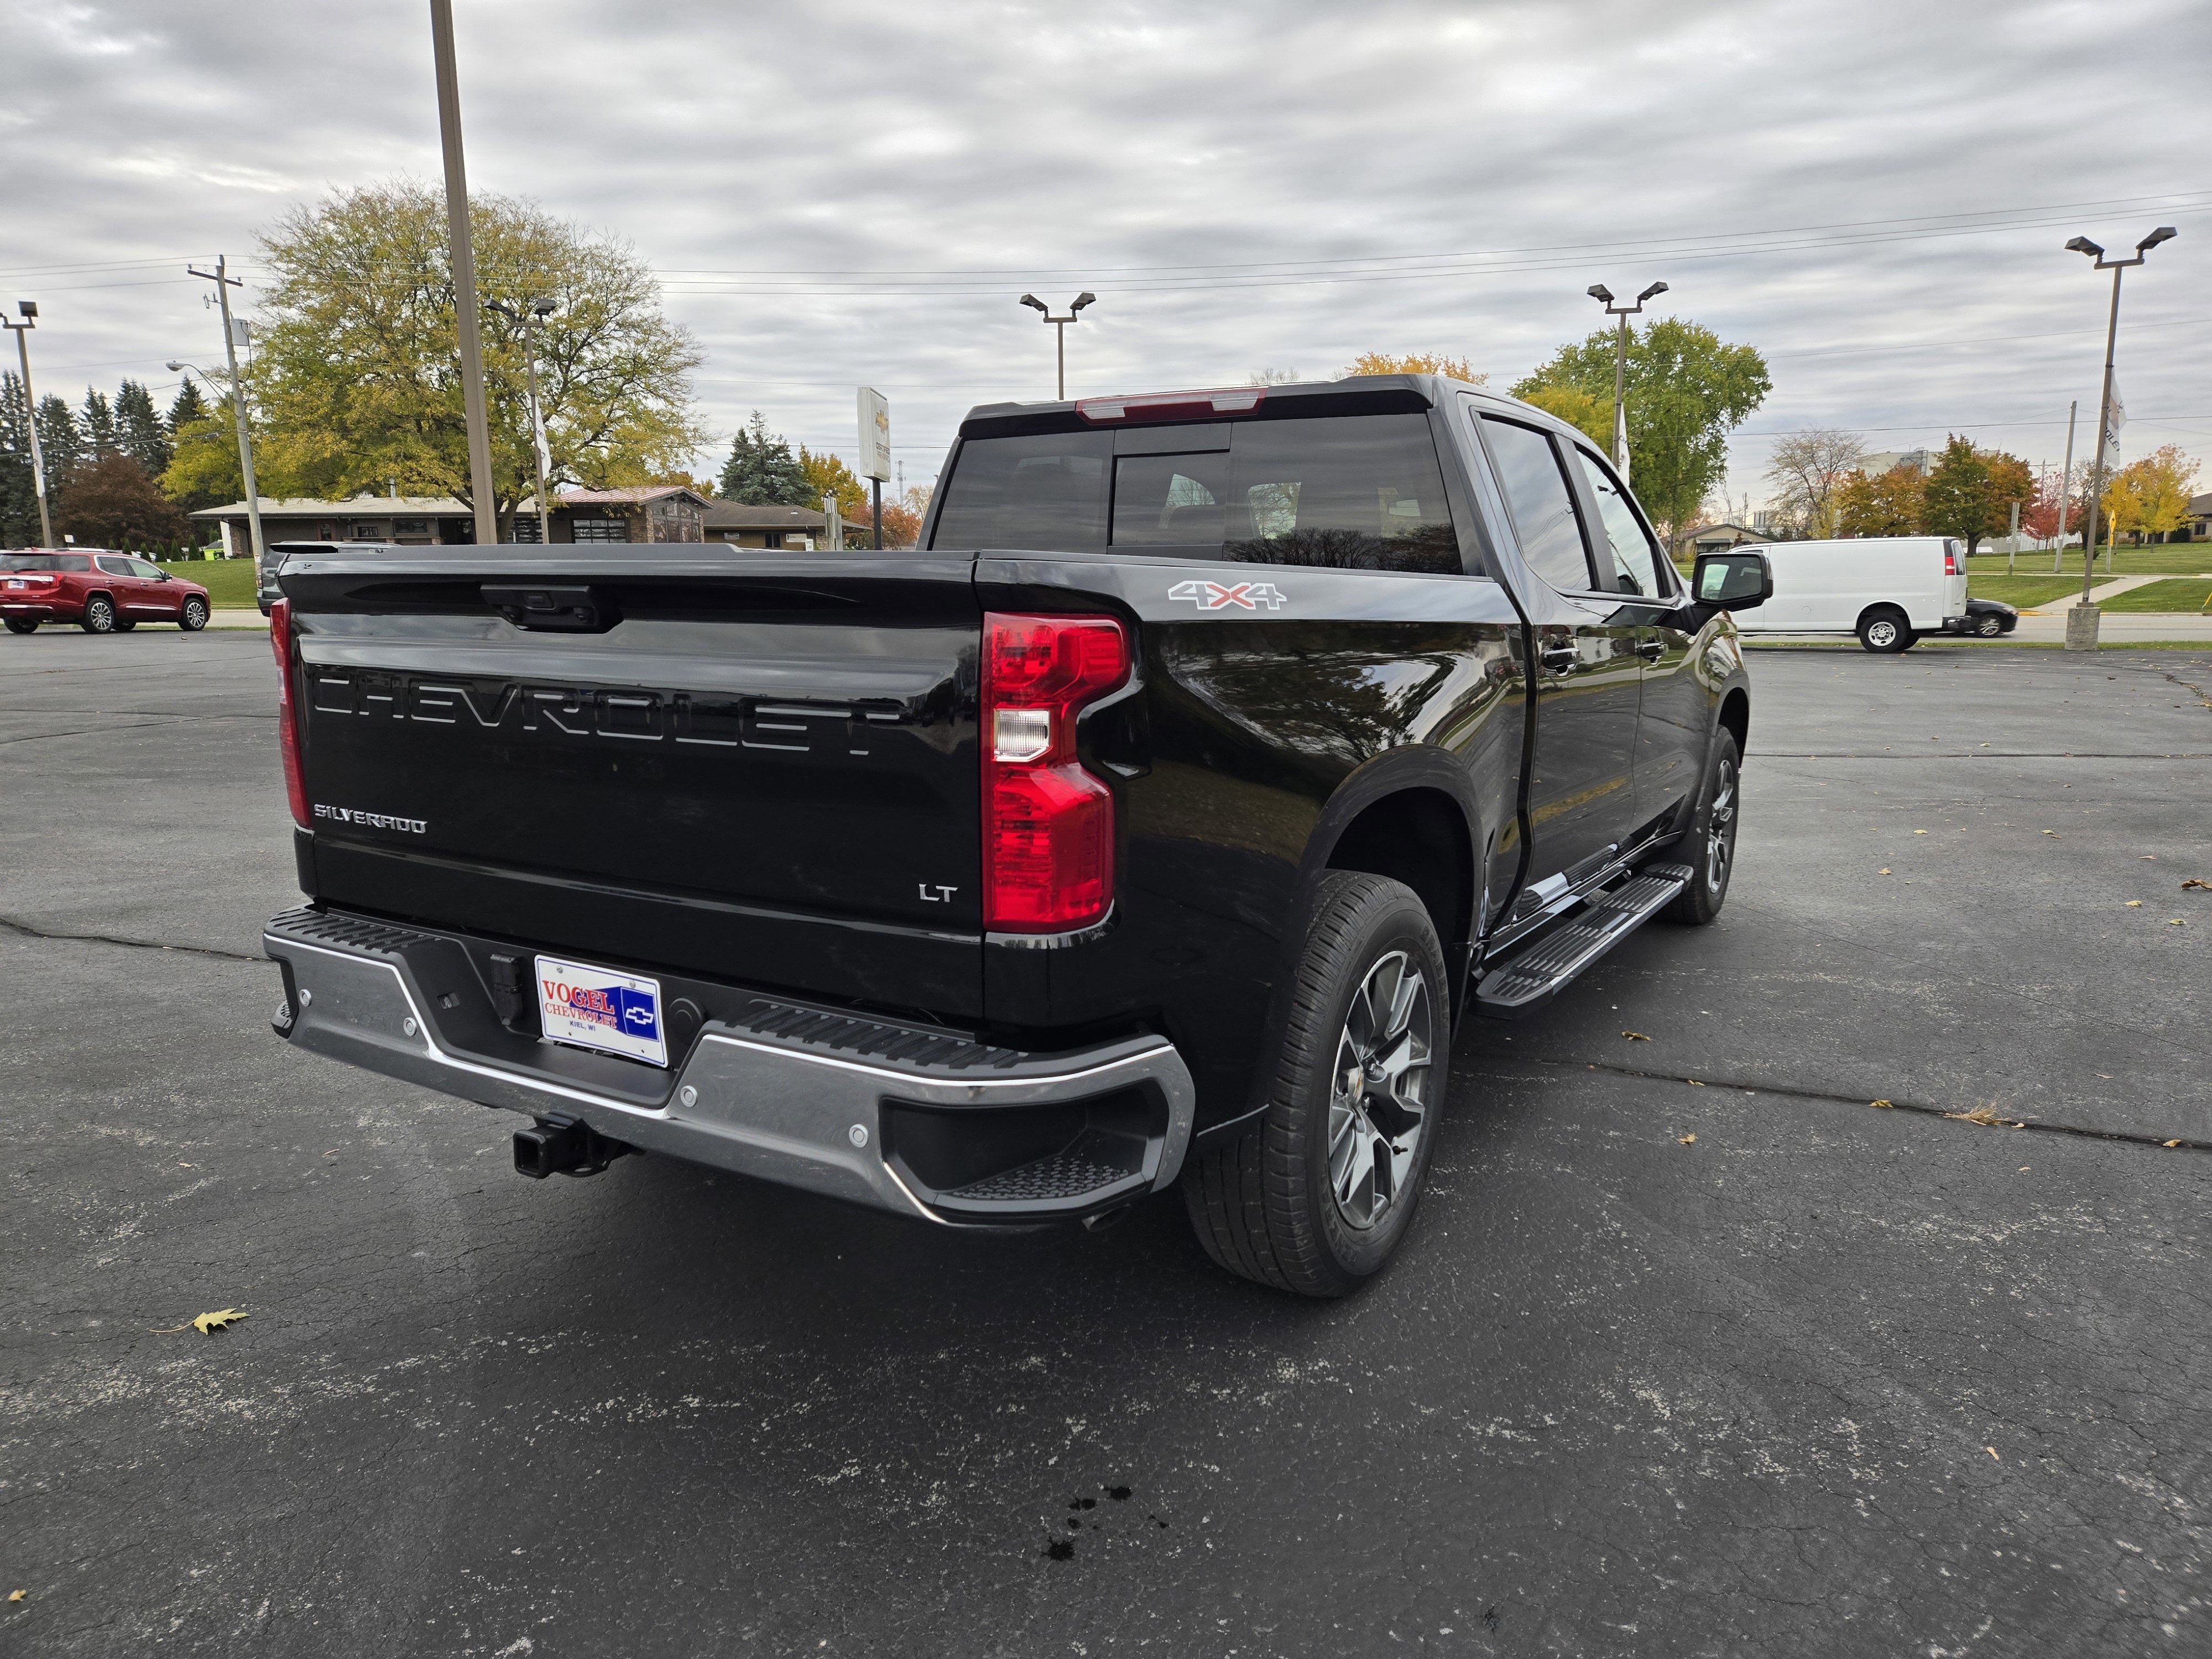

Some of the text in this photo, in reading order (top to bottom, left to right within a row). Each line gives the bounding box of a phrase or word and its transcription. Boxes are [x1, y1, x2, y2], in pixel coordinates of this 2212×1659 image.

[314, 676, 901, 755] CHEVROLET
[314, 804, 427, 834] SILVERADO
[919, 884, 958, 902] LT
[542, 980, 615, 1014] VOGEL
[545, 1003, 617, 1029] CHEVROLET
[570, 1020, 586, 1030] KIEL,
